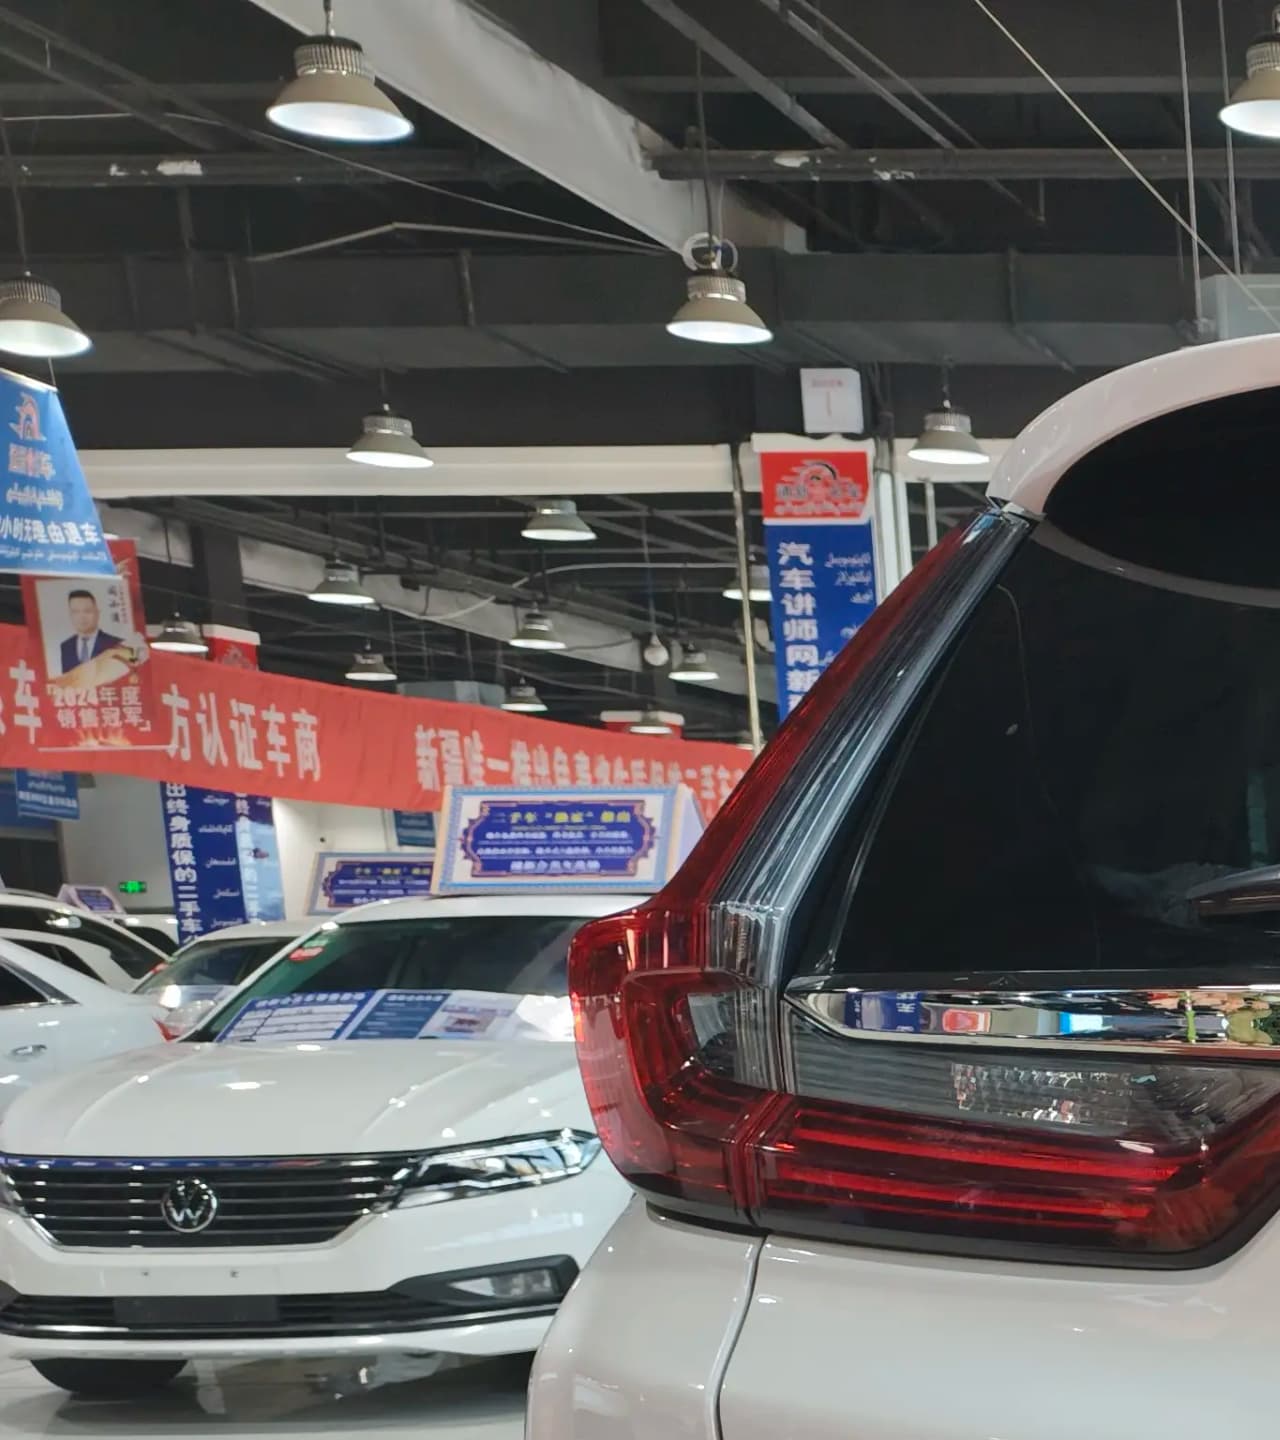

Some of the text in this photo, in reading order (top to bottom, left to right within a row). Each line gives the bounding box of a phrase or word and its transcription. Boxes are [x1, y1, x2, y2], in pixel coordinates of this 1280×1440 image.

[161, 682, 321, 782] 方认证车商
